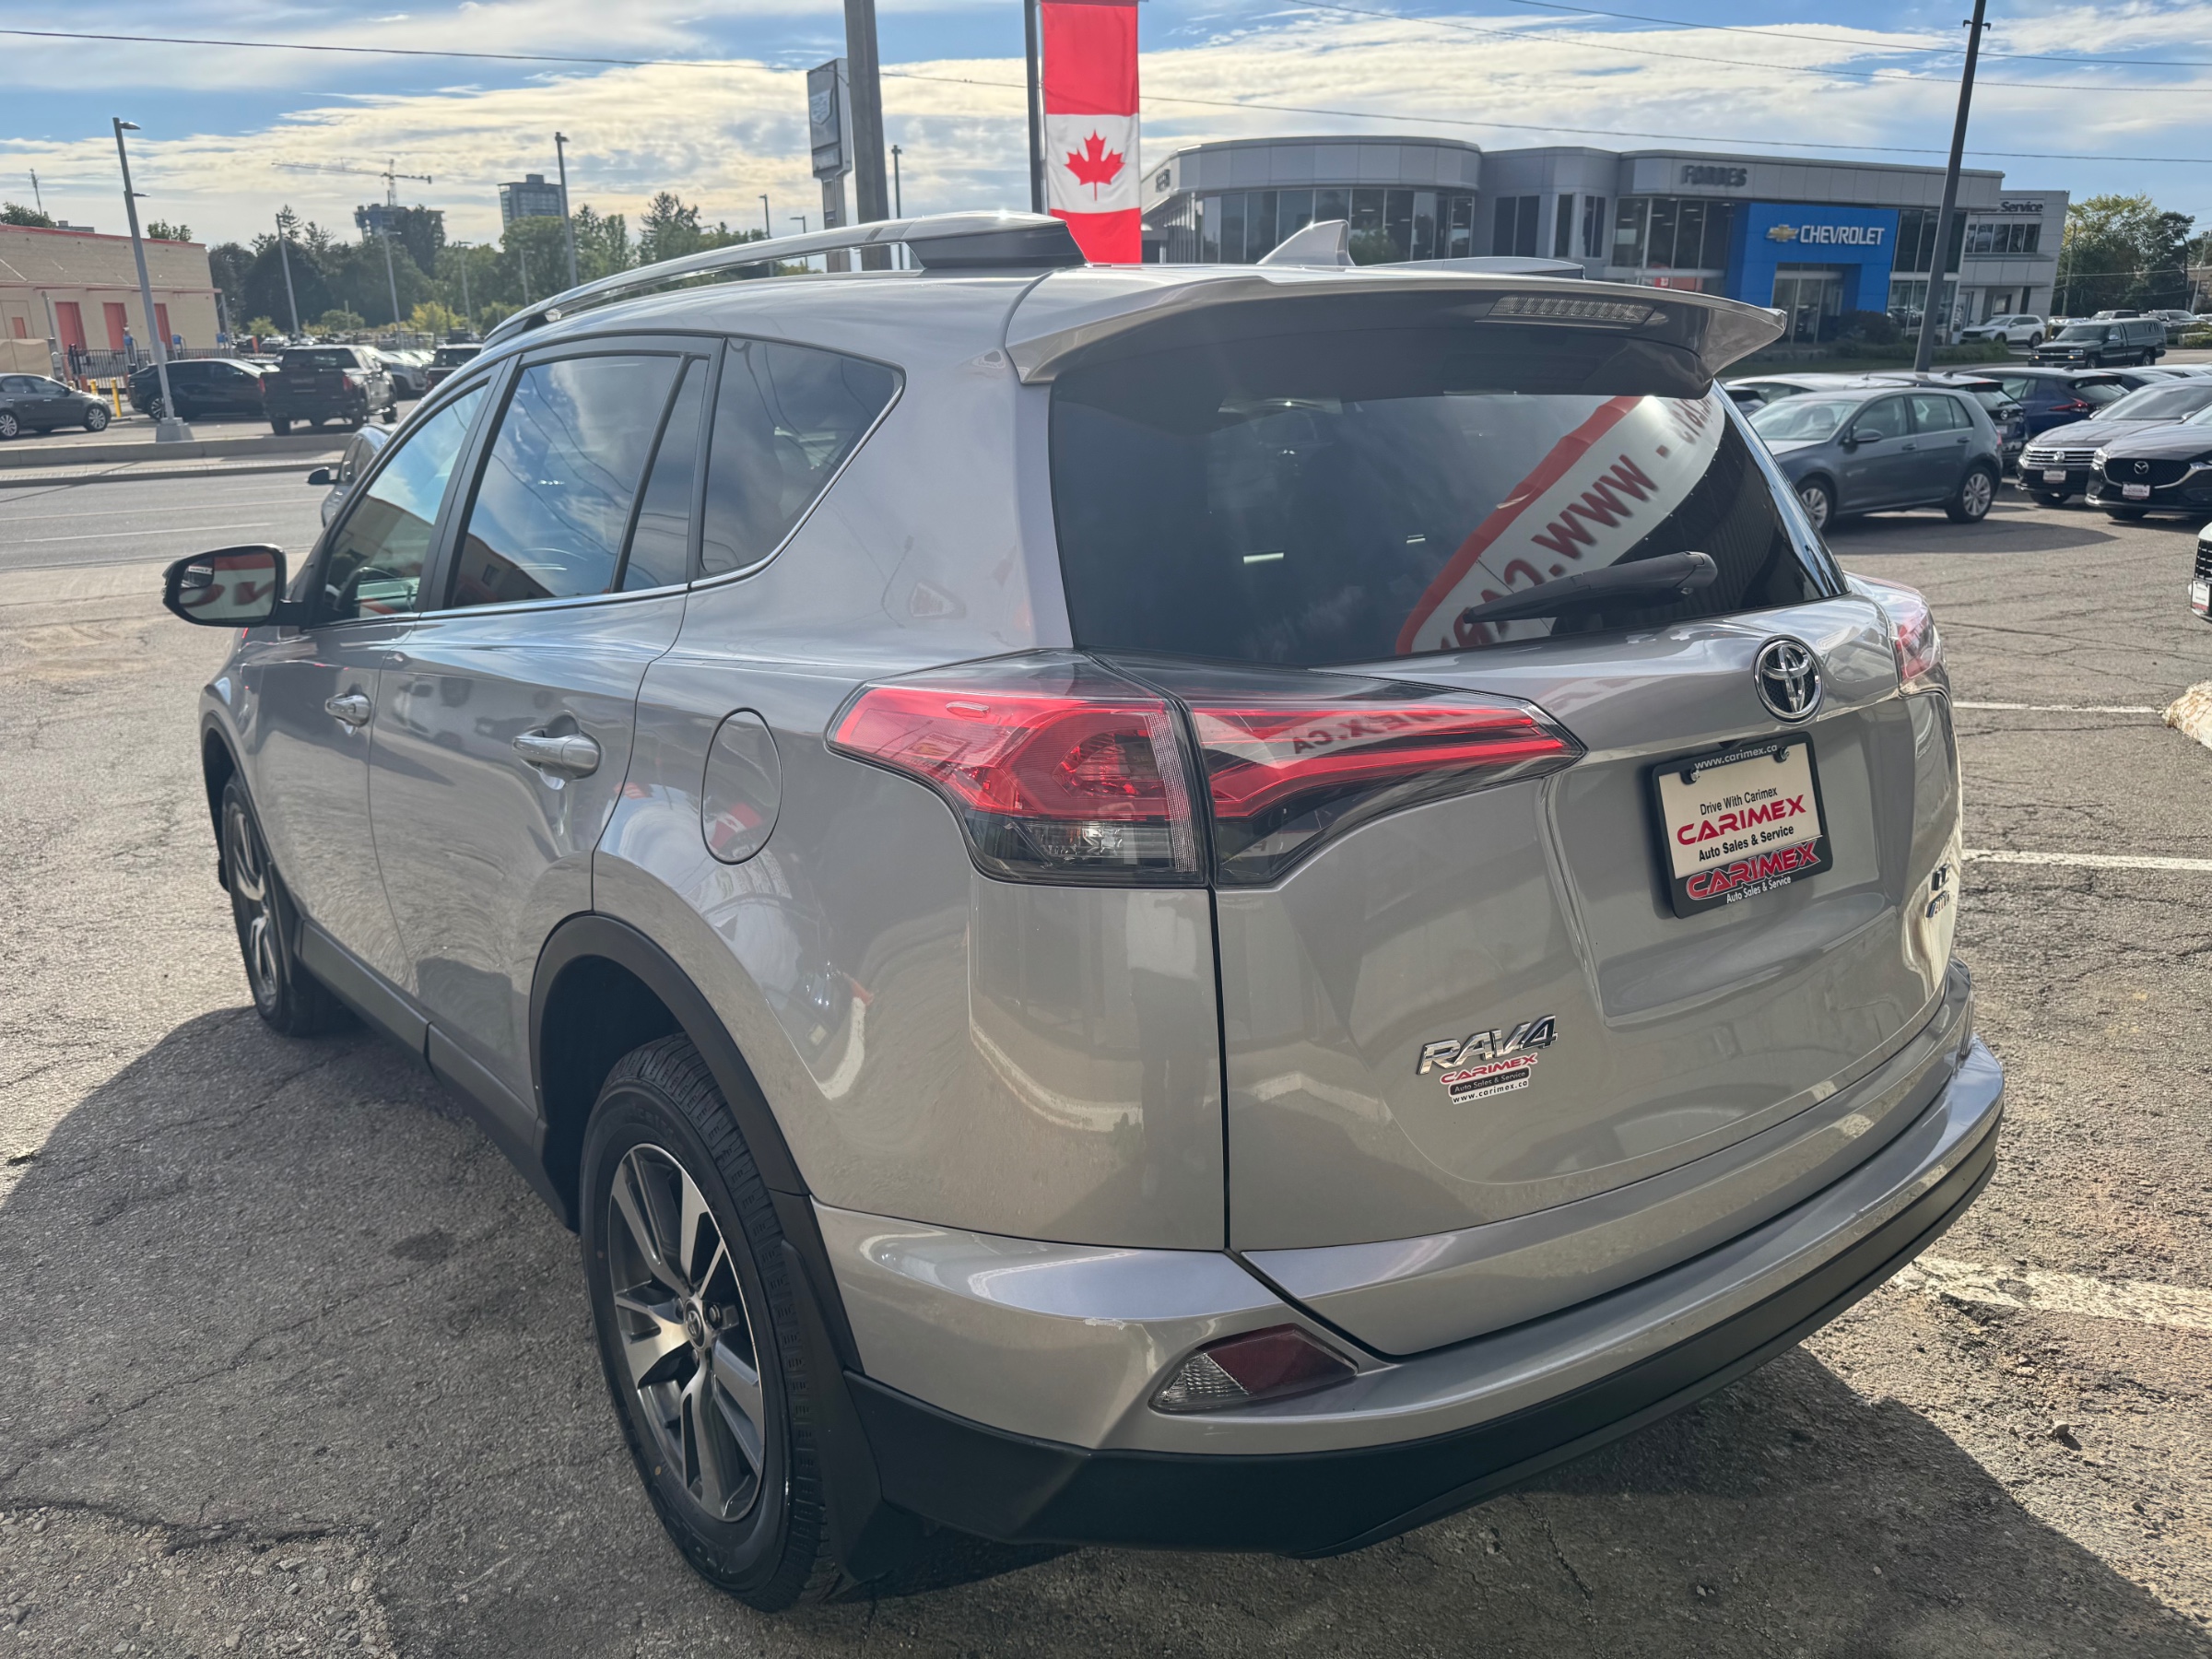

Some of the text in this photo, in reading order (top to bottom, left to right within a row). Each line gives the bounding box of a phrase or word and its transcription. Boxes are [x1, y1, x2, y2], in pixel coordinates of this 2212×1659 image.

[2000, 201, 2043, 213] Service
[1799, 225, 1885, 245] CHEVROLET
[1694, 744, 1778, 770] www.carimex.ca
[1700, 787, 1778, 816] Drive With Carimex
[1677, 794, 1806, 845] CARIMEX
[1699, 826, 1794, 862] Auto Sales & Service
[1686, 841, 1820, 900] CARIMEX
[1726, 876, 1792, 904] Auto Sales & Service
[1417, 1015, 1559, 1075] RAV4
[1441, 1053, 1537, 1084] CARIMEX
[1454, 1082, 1472, 1093] Auto
[1473, 1078, 1493, 1089] Sales
[1500, 1071, 1526, 1082] Service
[1453, 1080, 1528, 1103] www.carimex.ca
